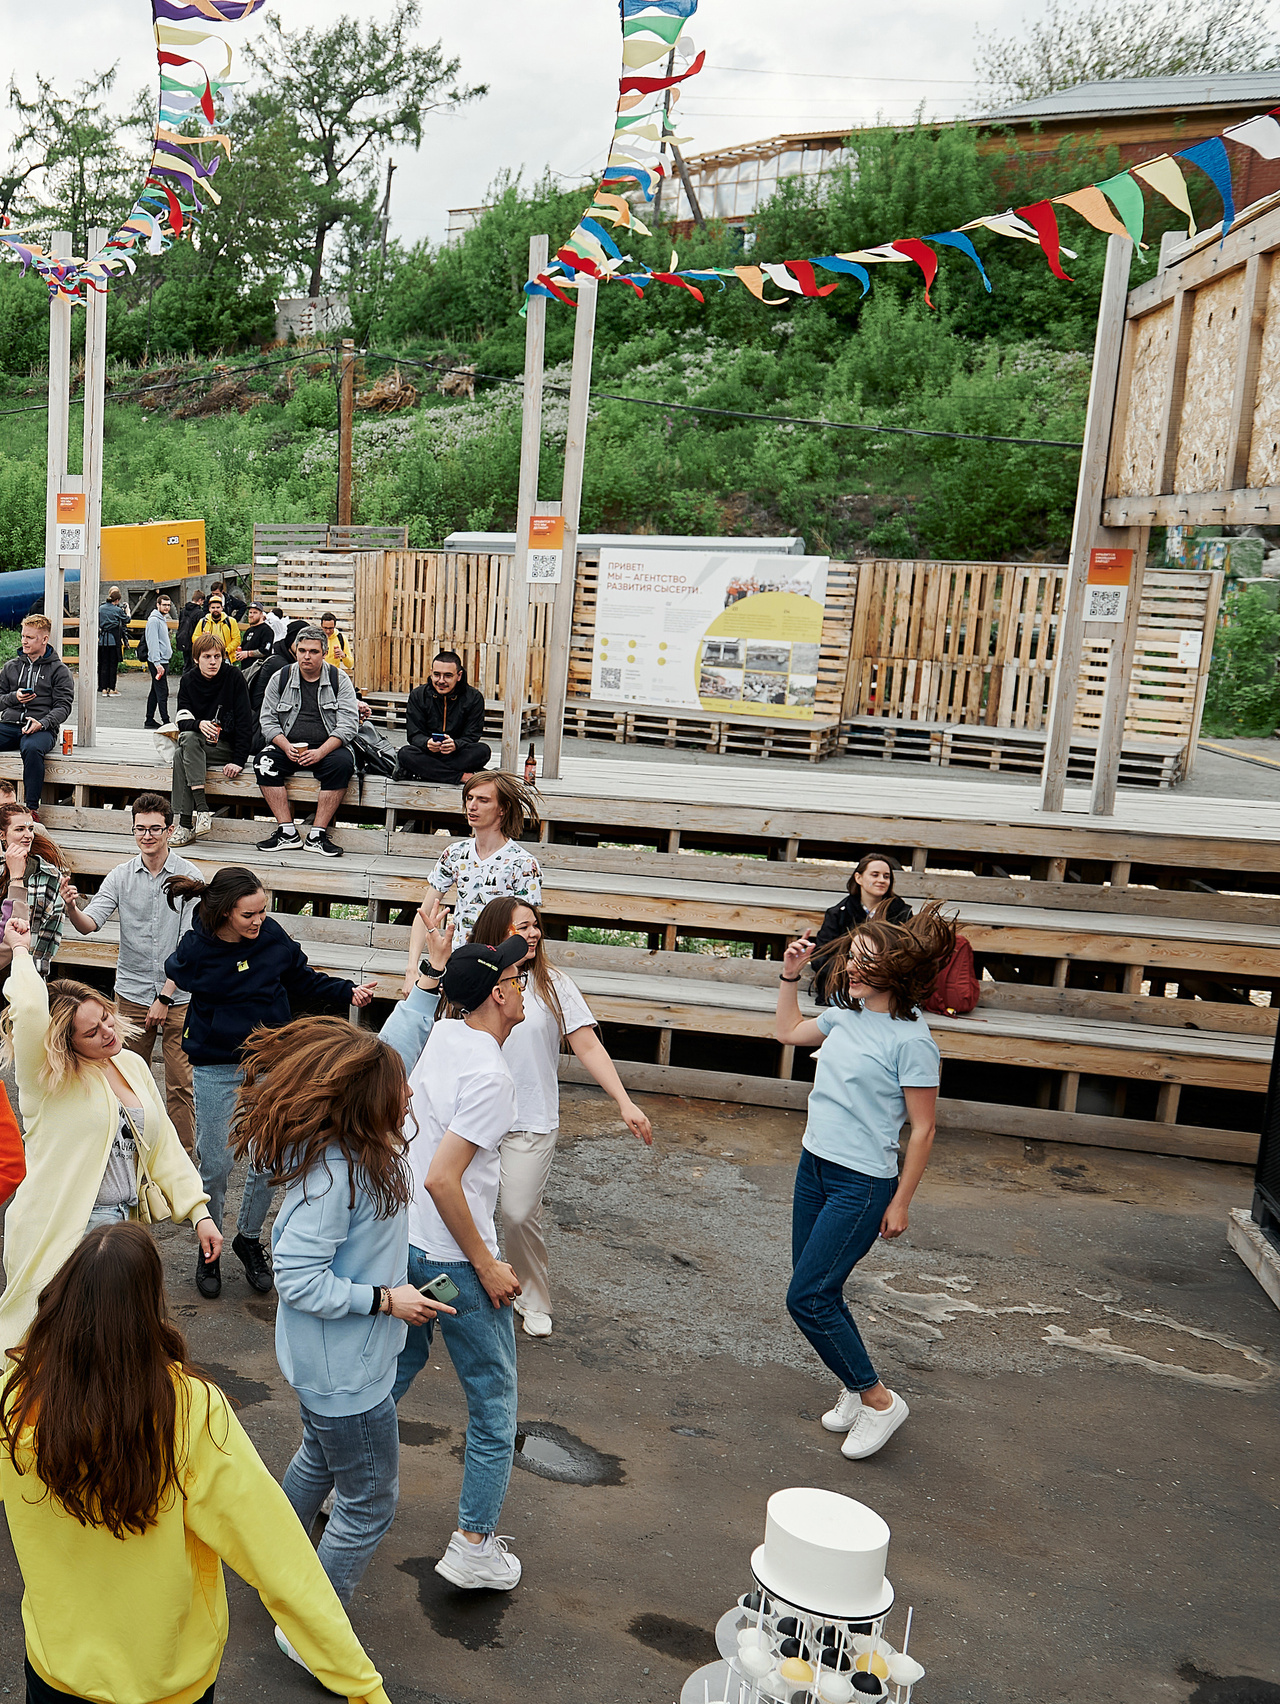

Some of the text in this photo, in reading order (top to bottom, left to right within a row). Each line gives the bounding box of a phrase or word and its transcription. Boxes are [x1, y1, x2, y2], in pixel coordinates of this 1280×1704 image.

[167, 536, 180, 545] JCB
[608, 562, 644, 571] ПРИВЕТ!
[607, 572, 622, 580] МЫ
[633, 573, 687, 583] АГЕНТСТВО
[606, 582, 652, 592] РАЗВИТИЯ
